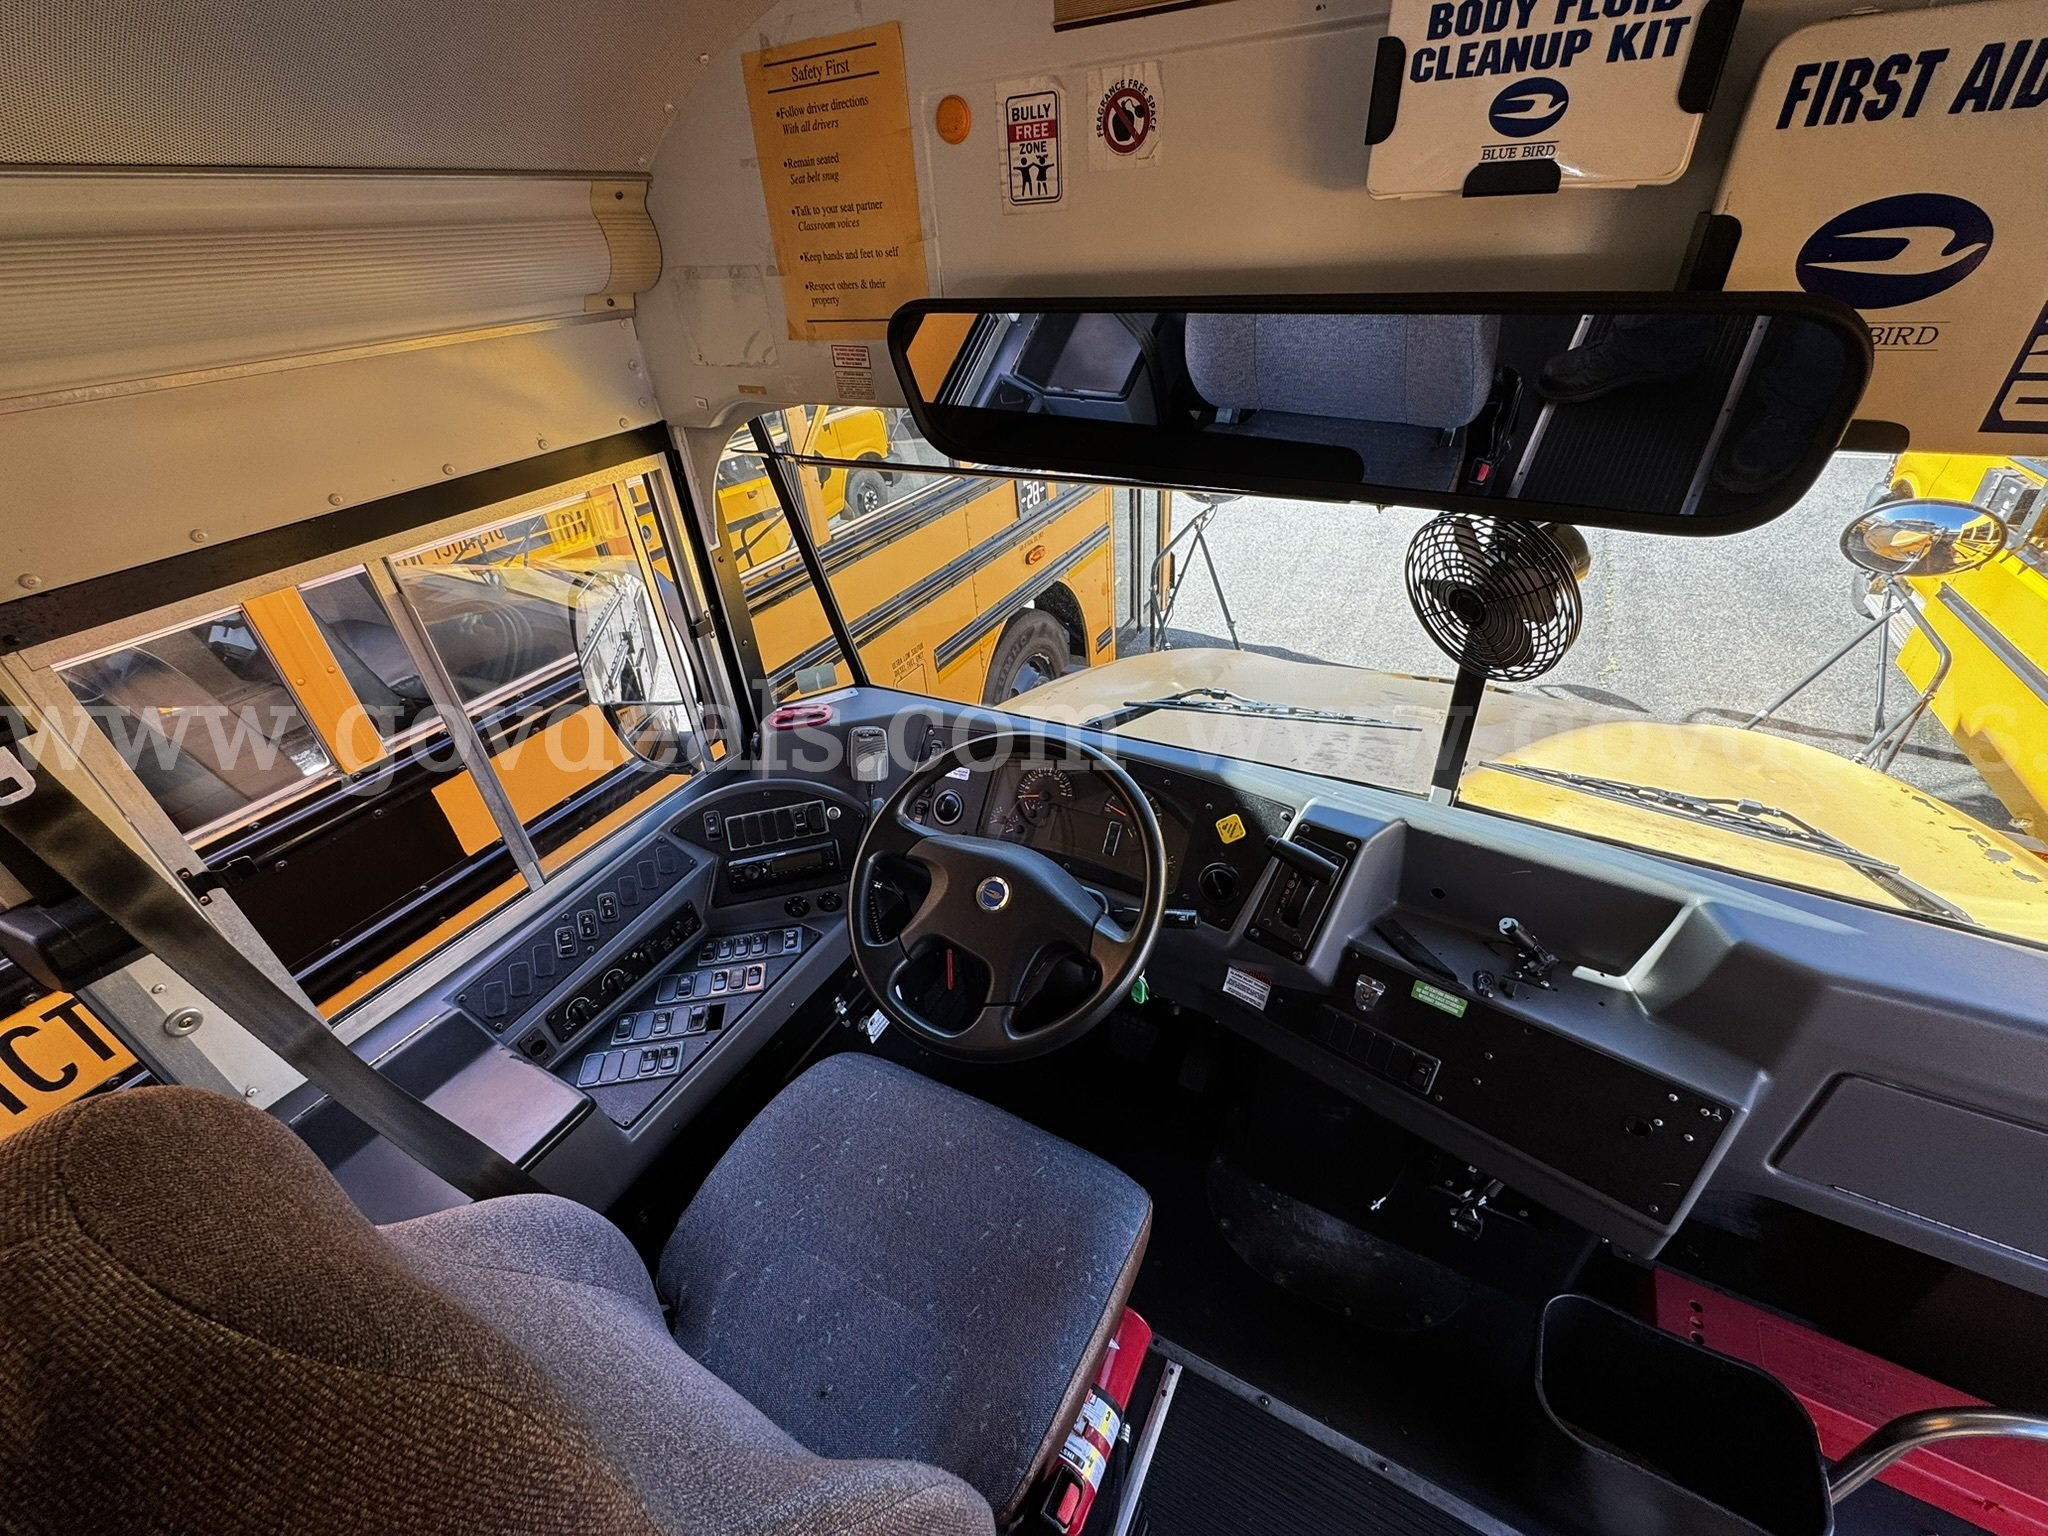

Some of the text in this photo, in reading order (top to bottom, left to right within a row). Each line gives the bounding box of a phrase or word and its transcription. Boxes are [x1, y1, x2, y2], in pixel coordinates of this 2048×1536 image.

[1427, 0, 1542, 41] BODY
[1409, 16, 1691, 83] CLEANUP KIT
[791, 58, 850, 82] Safety First
[1775, 47, 1951, 130] FIRST
[780, 95, 869, 119] Follow driver directions
[1011, 102, 1051, 123] BULLY
[1096, 78, 1157, 138] FRAGRANCE FREE SPACE
[782, 119, 840, 136] With all drivers
[1015, 122, 1050, 141] FREE
[1019, 141, 1047, 155] ZONE
[1481, 144, 1557, 160] BLUE BIRD
[787, 152, 840, 169] Remain seated
[790, 171, 840, 185] Seat belt snug
[795, 200, 883, 217] Talk to your seat partner
[797, 217, 860, 232] Classroom voices
[803, 246, 899, 264] Keep hands and feet to self
[808, 278, 886, 294] Respect others & their
[811, 296, 840, 308] property
[1868, 326, 1939, 346] BIRD
